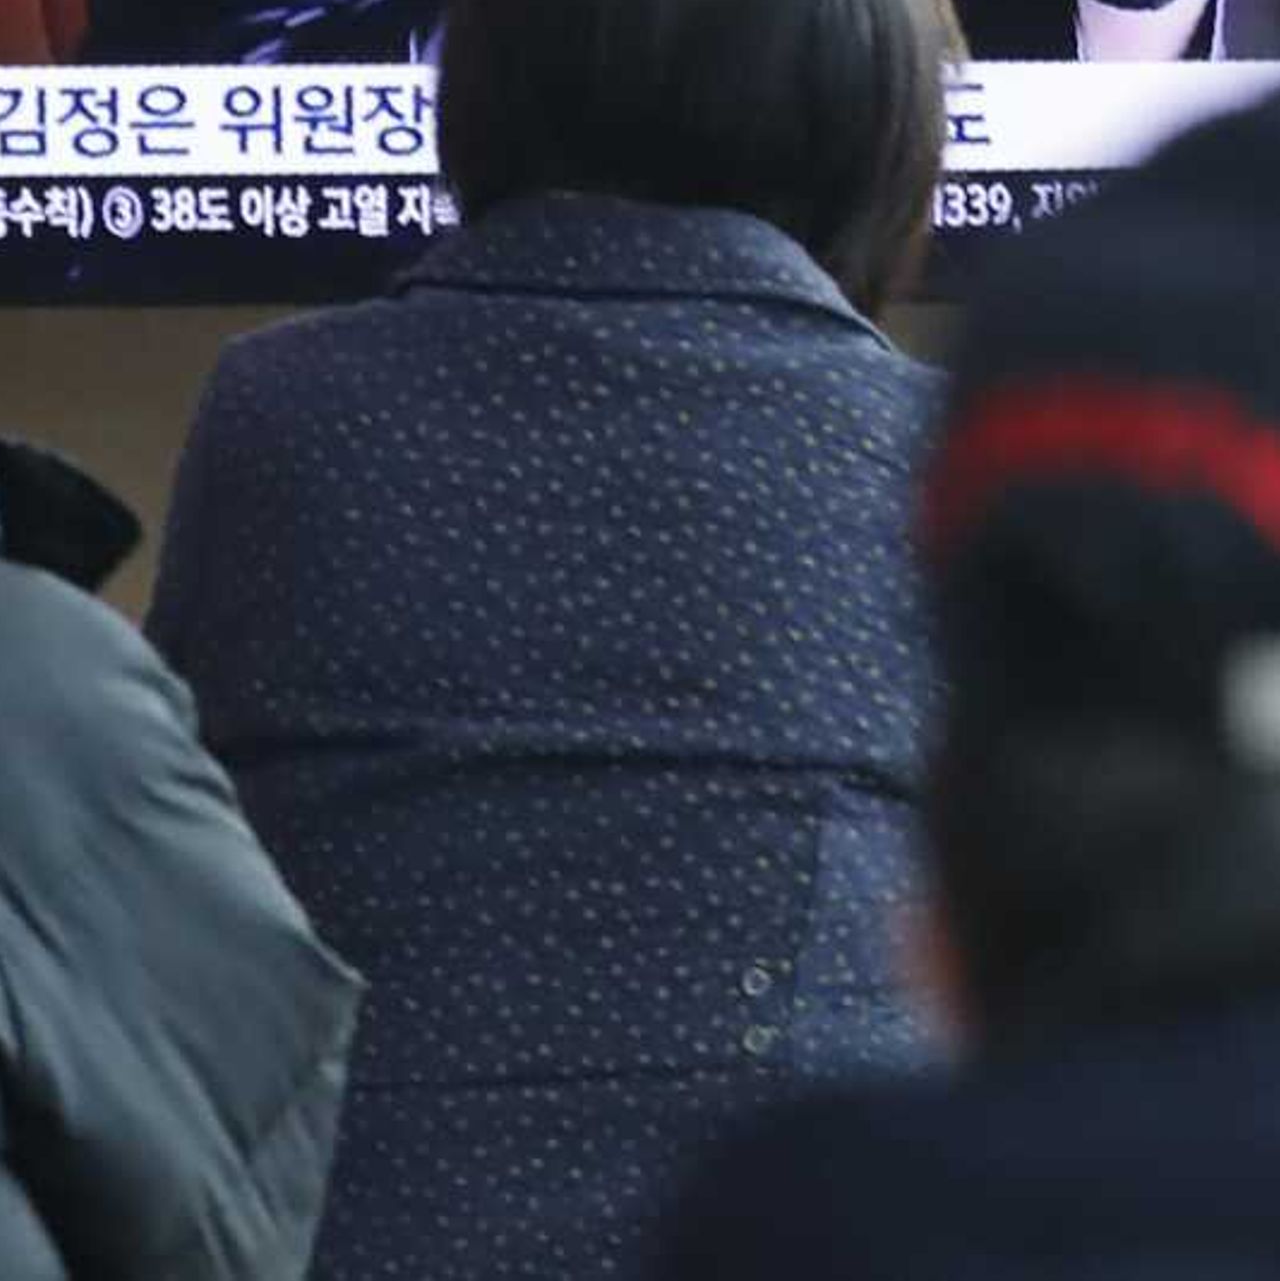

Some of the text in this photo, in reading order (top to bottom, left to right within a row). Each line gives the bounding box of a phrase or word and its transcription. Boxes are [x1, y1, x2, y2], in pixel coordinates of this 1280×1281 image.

[219, 84, 434, 157] 위원장
[151, 187, 234, 231] 38도
[239, 184, 311, 238] 이상
[318, 183, 389, 236] 고열
